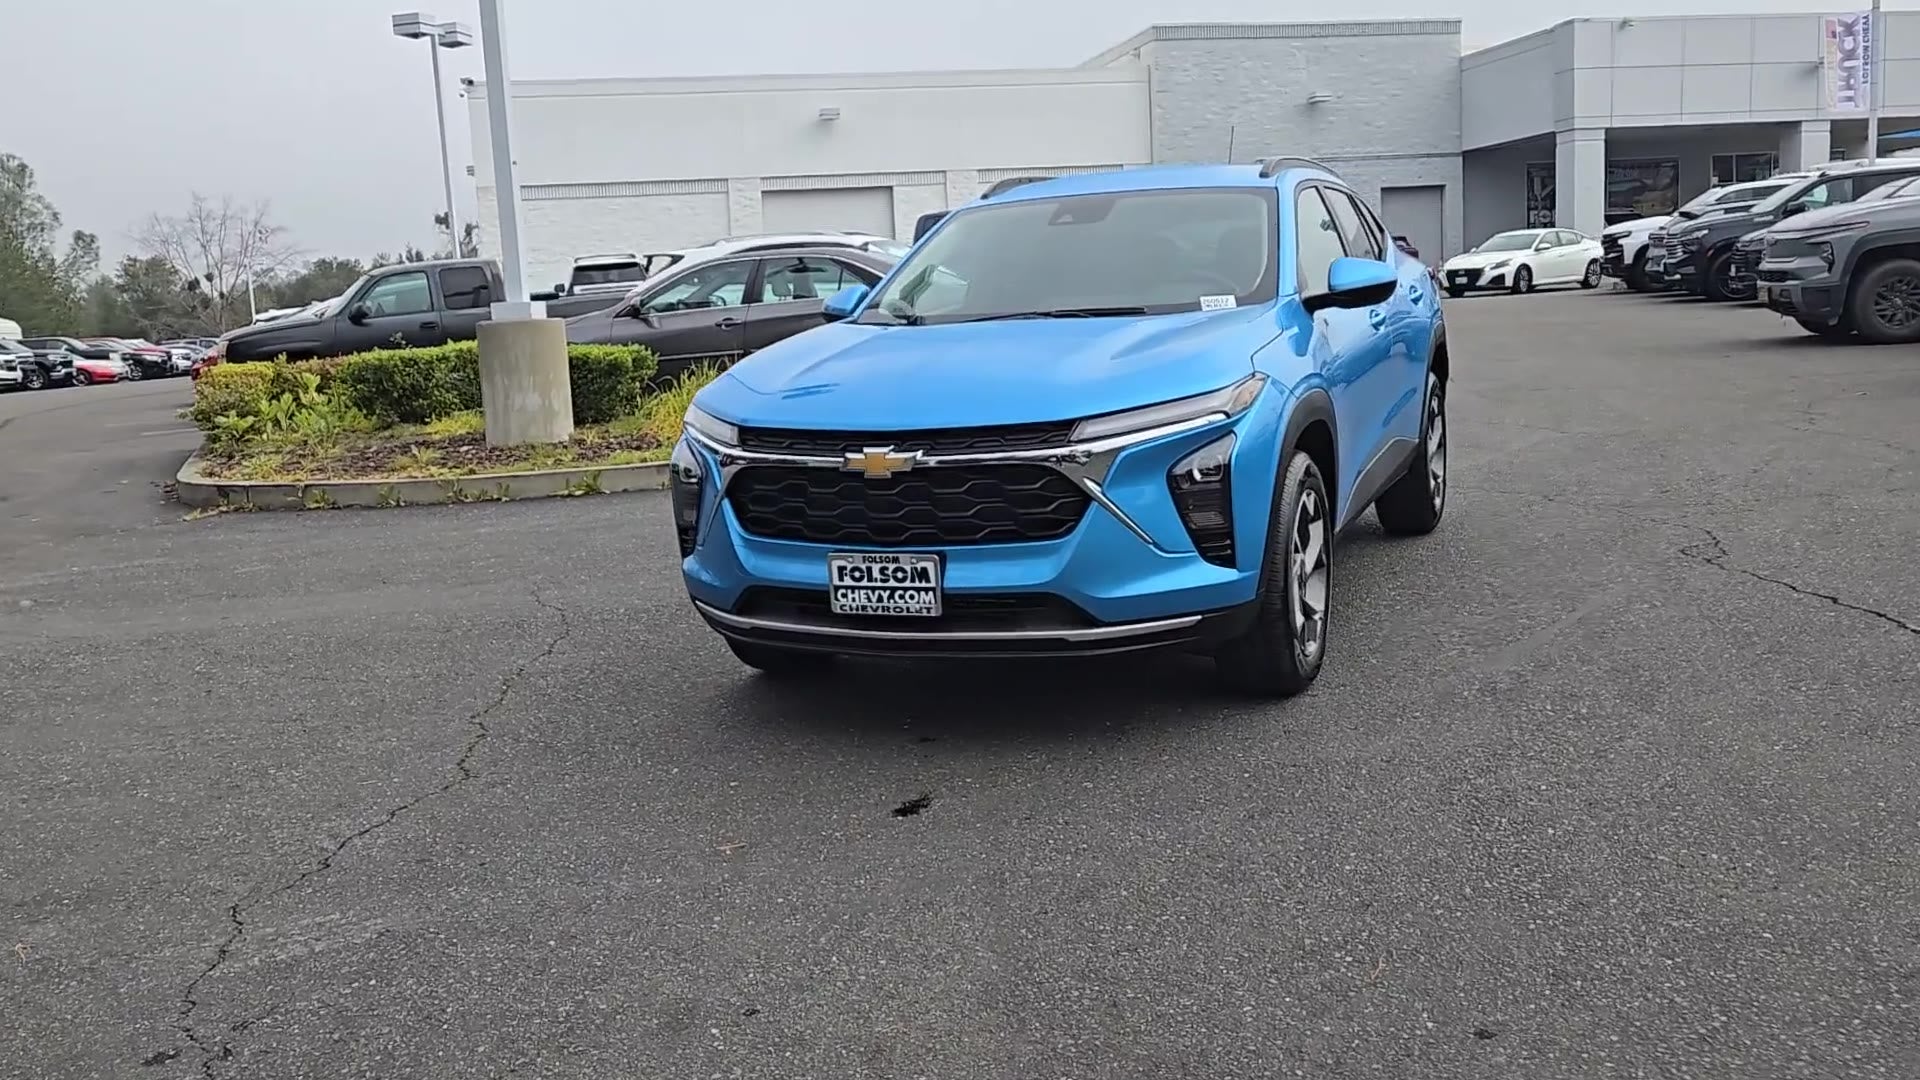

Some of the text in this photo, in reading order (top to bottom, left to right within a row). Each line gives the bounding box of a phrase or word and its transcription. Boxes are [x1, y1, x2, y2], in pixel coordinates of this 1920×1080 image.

[862, 555, 901, 564] FOLSOM
[837, 565, 932, 584] FOLSOM
[837, 588, 935, 604] CHEVY.COM
[838, 604, 934, 614] CHEVROLET
